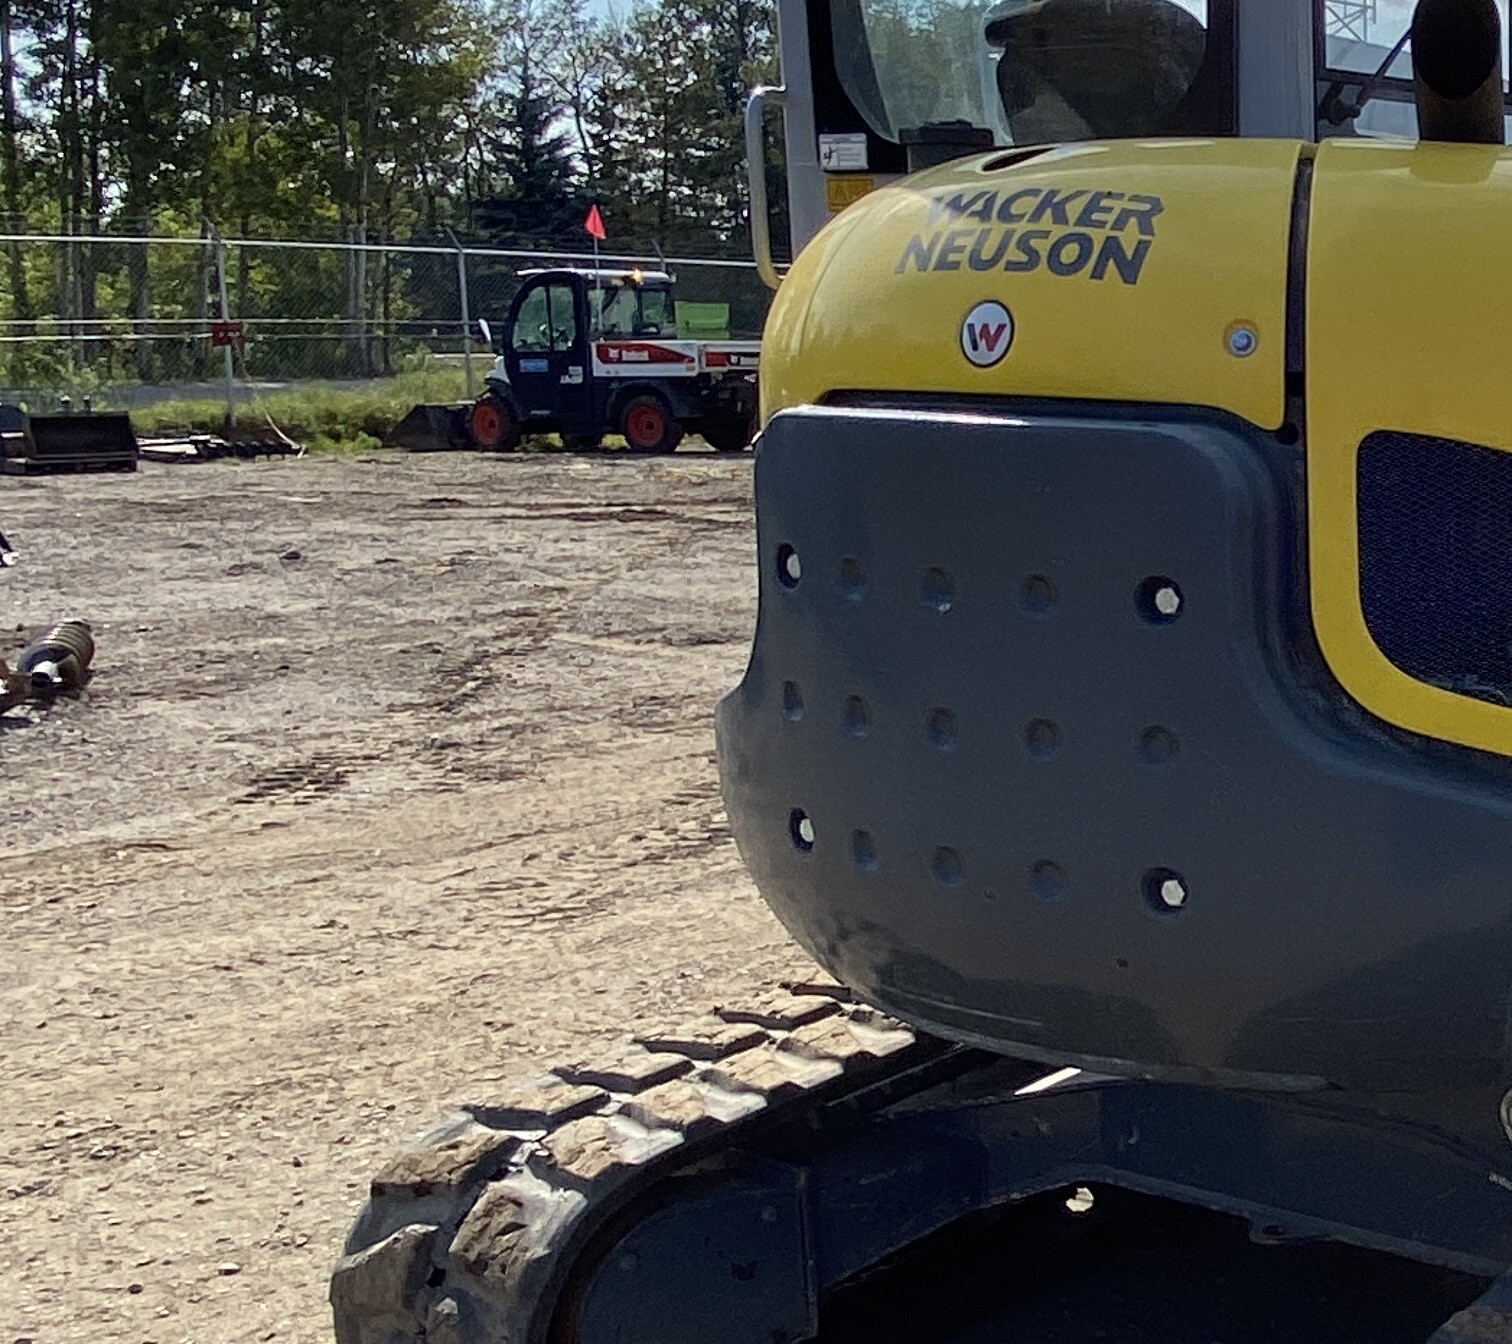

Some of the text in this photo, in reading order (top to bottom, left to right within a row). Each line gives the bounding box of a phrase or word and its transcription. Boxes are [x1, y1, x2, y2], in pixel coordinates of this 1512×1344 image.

[927, 188, 1164, 237] WACKER
[895, 227, 1152, 285] NEUSON
[967, 323, 1007, 352] W
